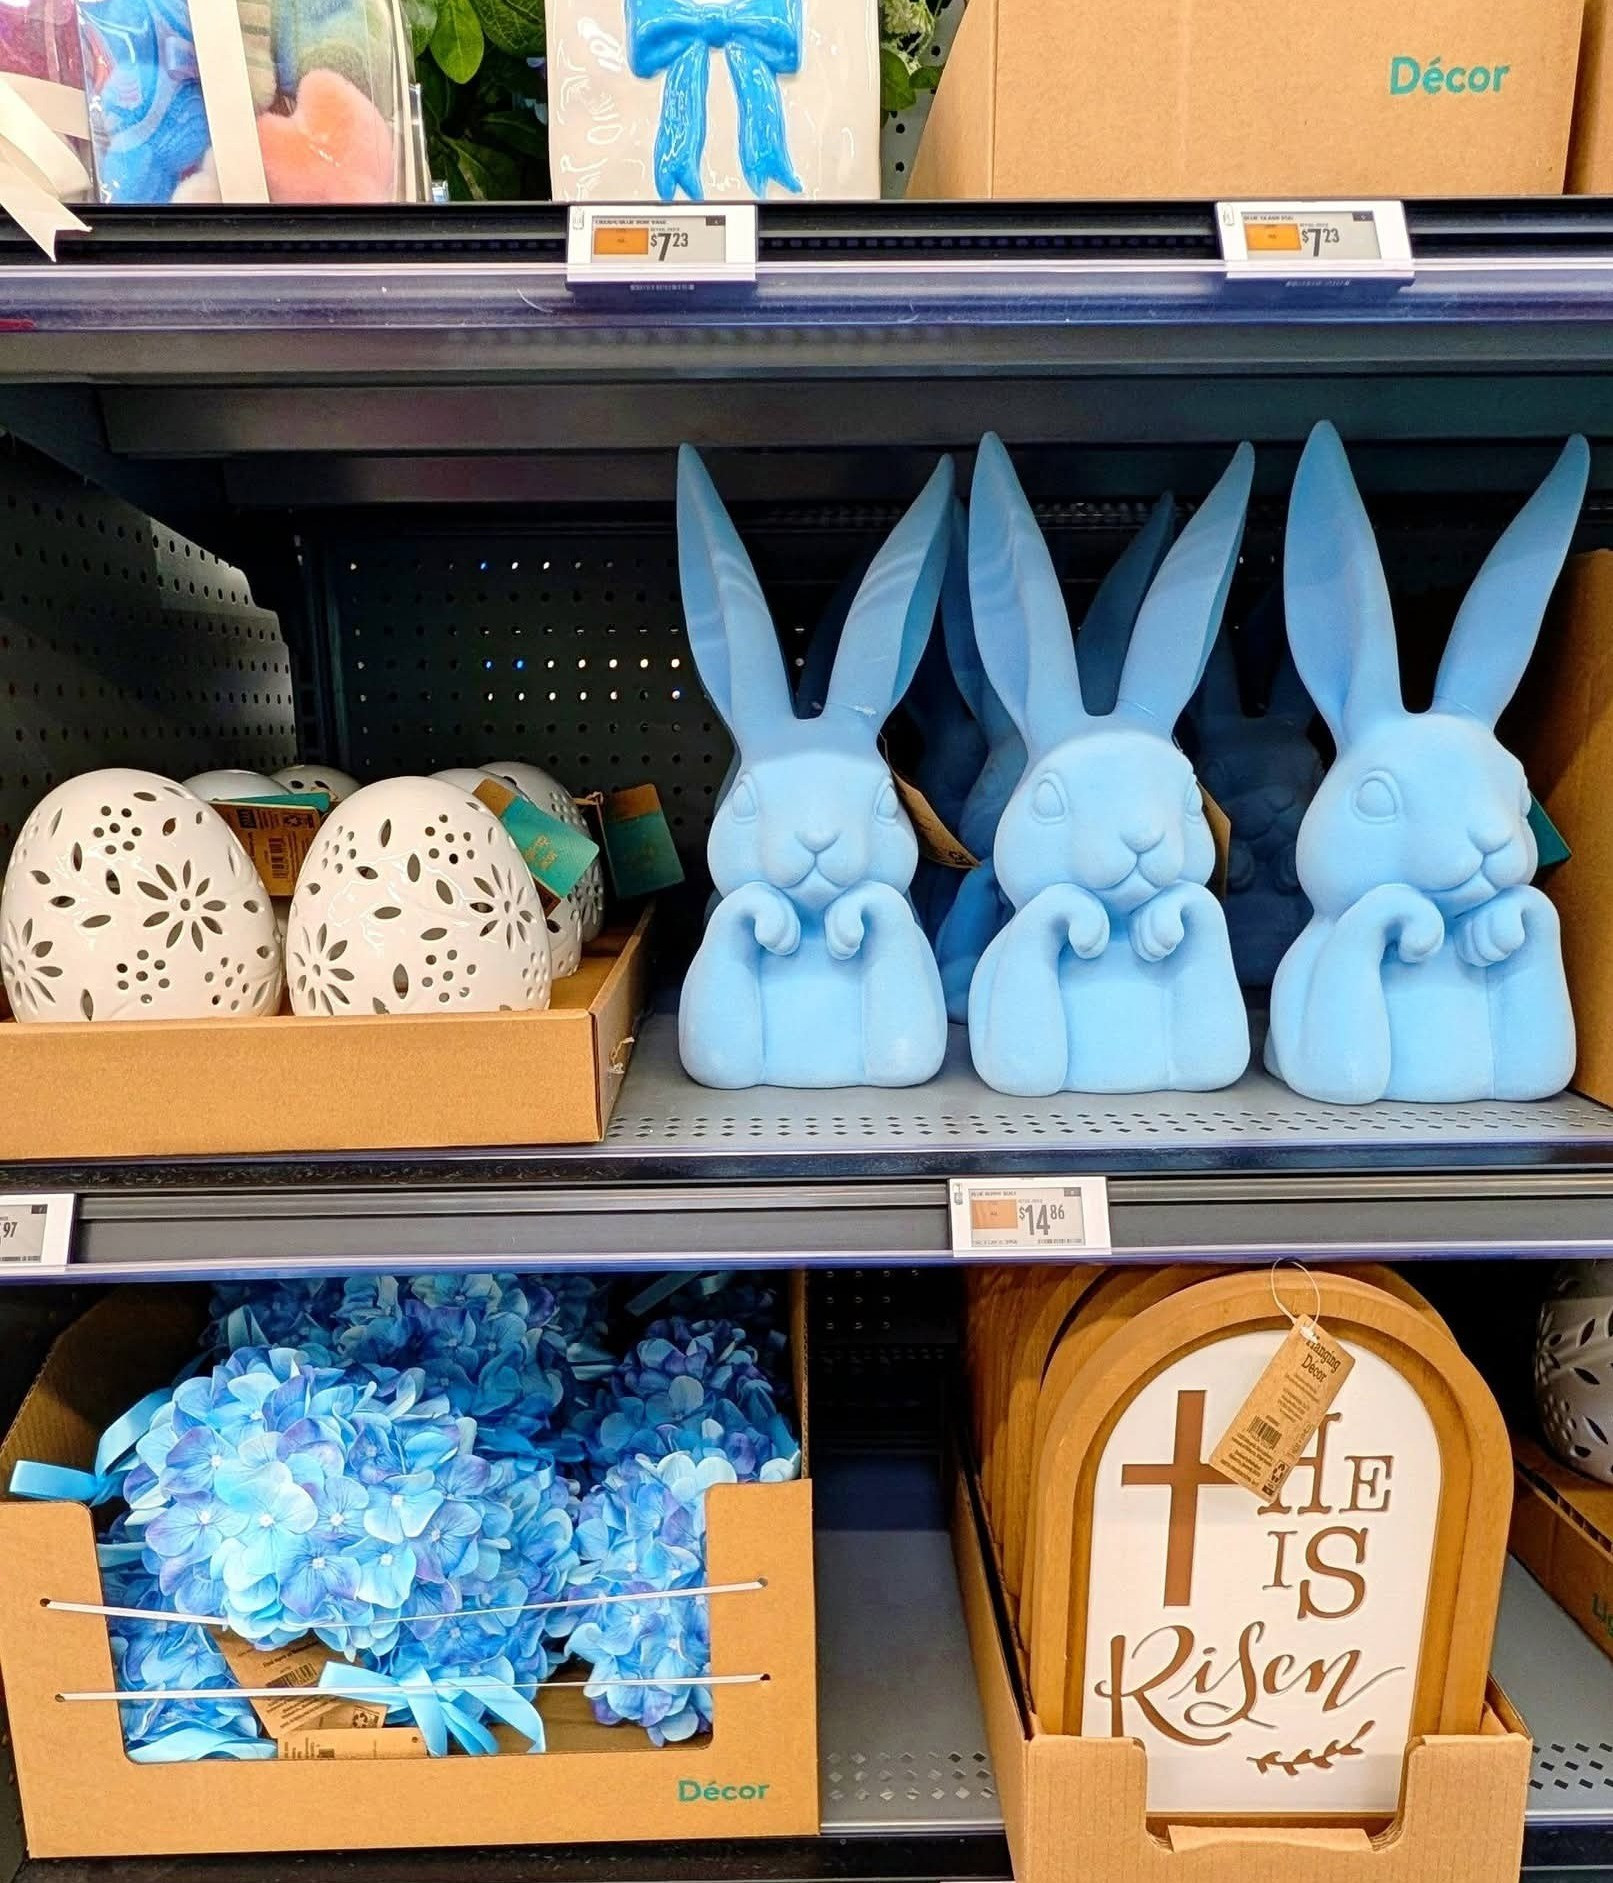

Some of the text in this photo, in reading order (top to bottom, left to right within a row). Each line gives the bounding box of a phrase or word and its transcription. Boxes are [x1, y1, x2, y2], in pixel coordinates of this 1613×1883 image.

[1390, 56, 1510, 95] Décor
[1301, 1353, 1327, 1382] Décor
[1263, 1526, 1369, 1620] IS
[678, 1780, 770, 1801] Décor
